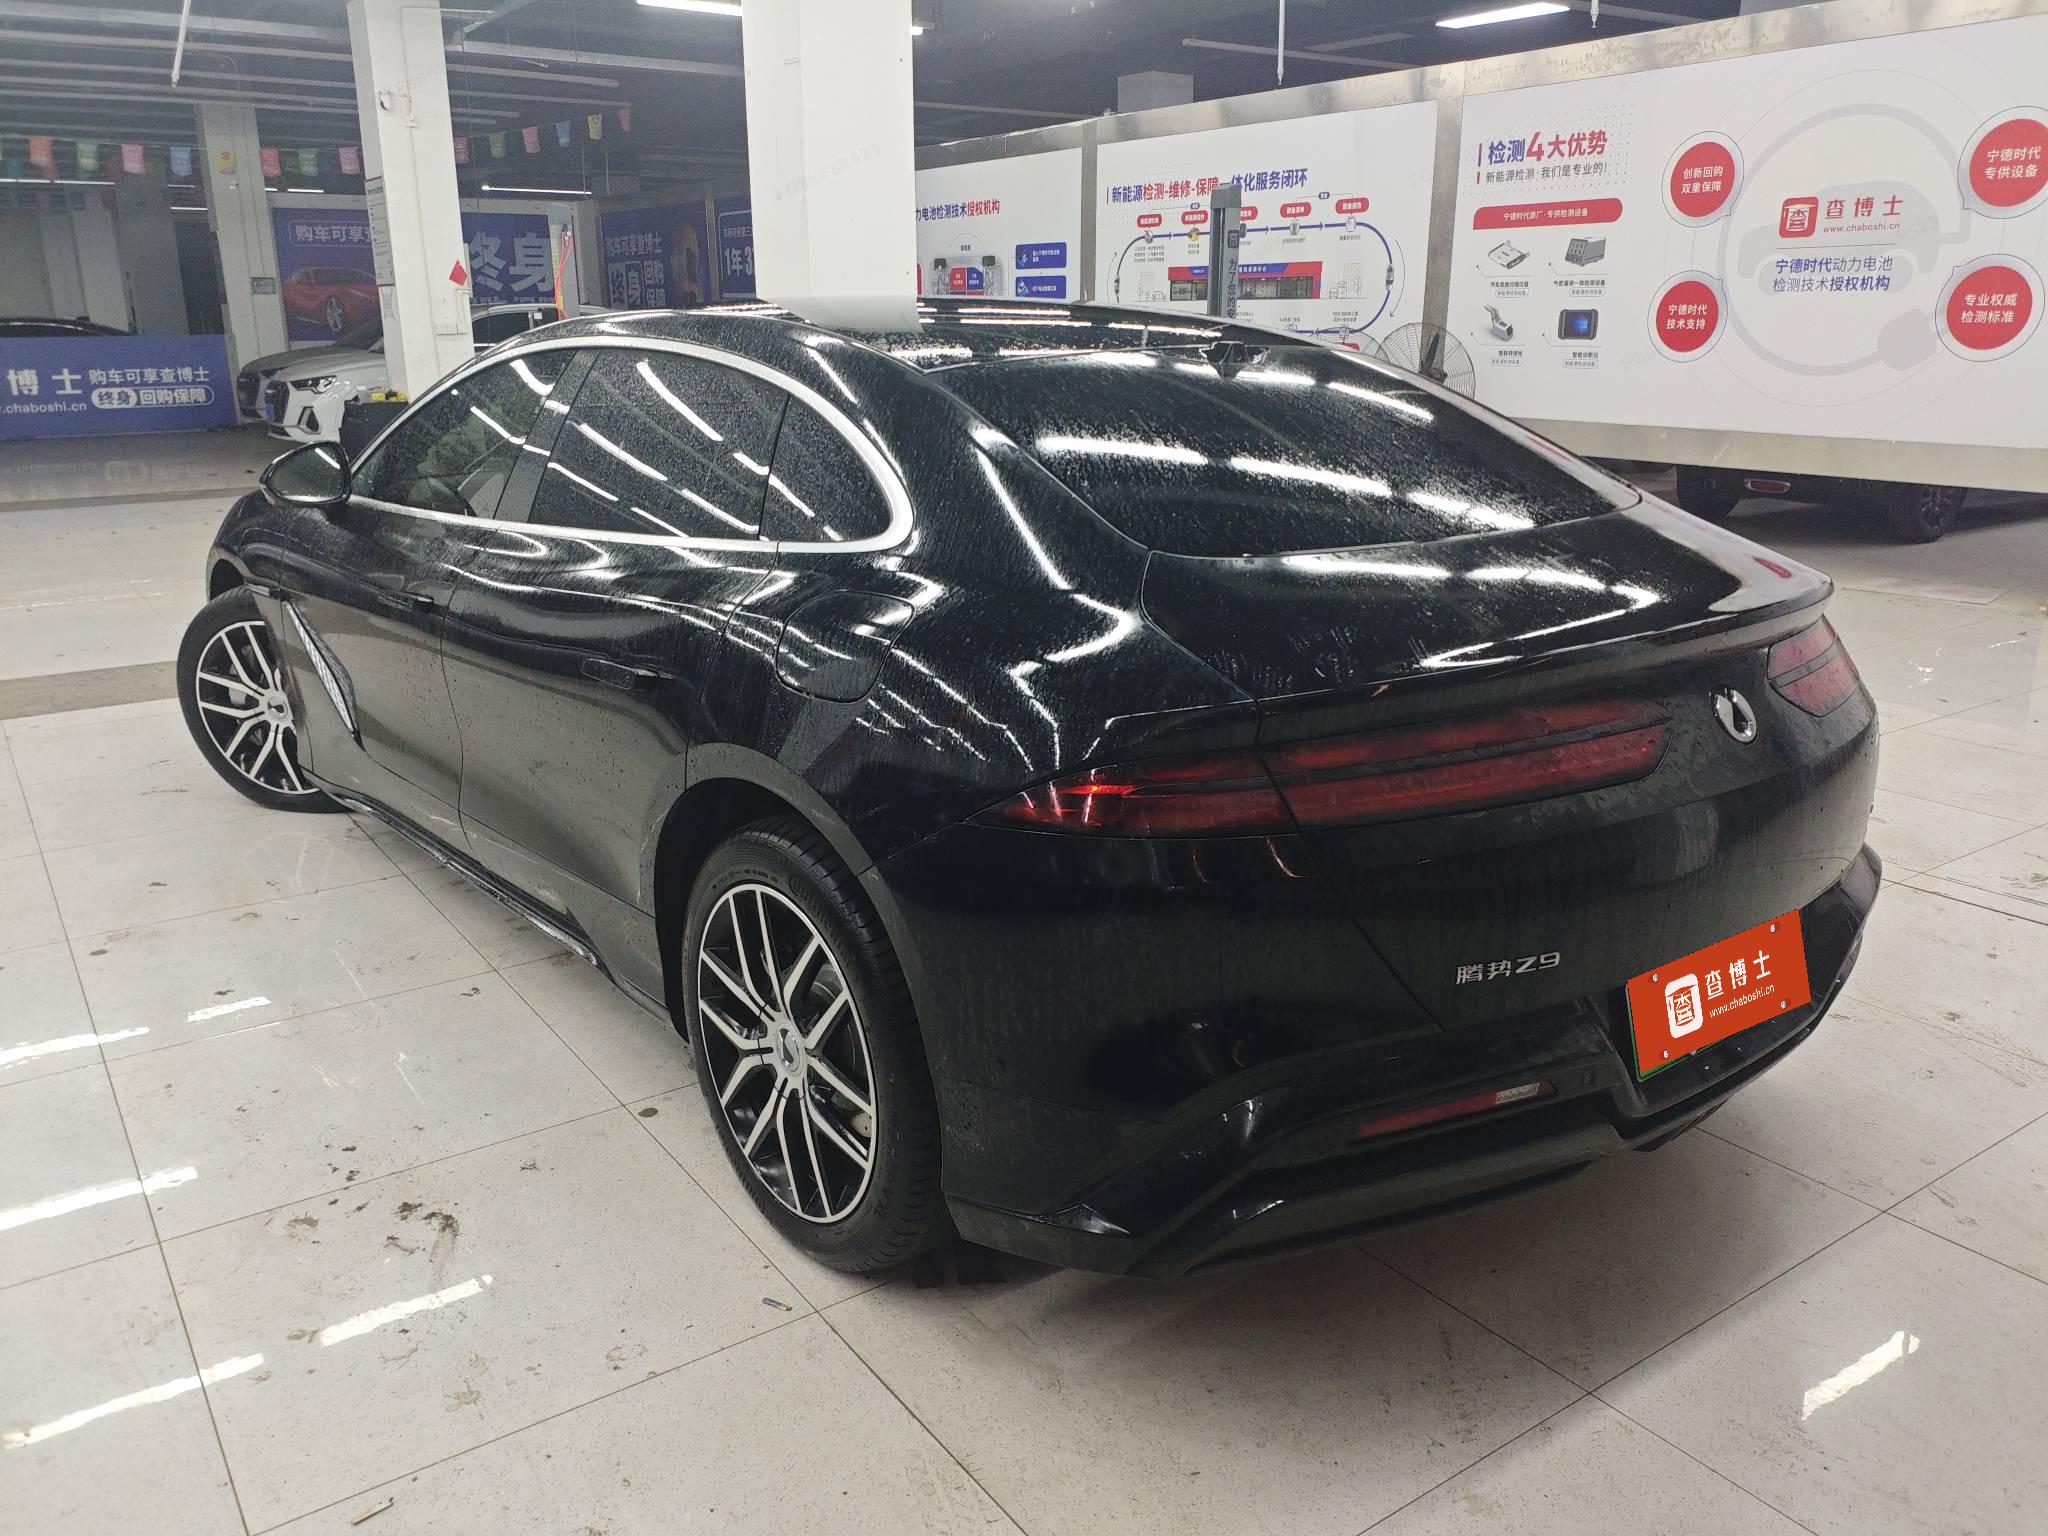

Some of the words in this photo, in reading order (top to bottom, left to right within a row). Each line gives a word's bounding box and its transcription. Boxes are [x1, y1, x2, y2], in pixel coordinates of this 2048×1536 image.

[1488, 130, 1608, 165] 检测4大优势
[1987, 146, 2042, 163] 宁德时代
[1683, 165, 1724, 180] 创新回购
[1984, 164, 2039, 180] 专供设备
[1681, 180, 1722, 194] 双重保障
[1825, 195, 1903, 220] 查博士
[1823, 222, 1900, 233] www.chaboshi.cn
[469, 231, 555, 293] 终身
[1776, 255, 1893, 274] 宁德时代动力电池
[1773, 275, 1890, 293] 检测技术授权机构
[1964, 293, 2018, 307] 专业权威
[1668, 304, 1708, 316] 宁德时代
[1961, 309, 2015, 324] 检测标准
[1666, 318, 1707, 330] 技术支持
[89, 366, 210, 386] 购车可享查博士
